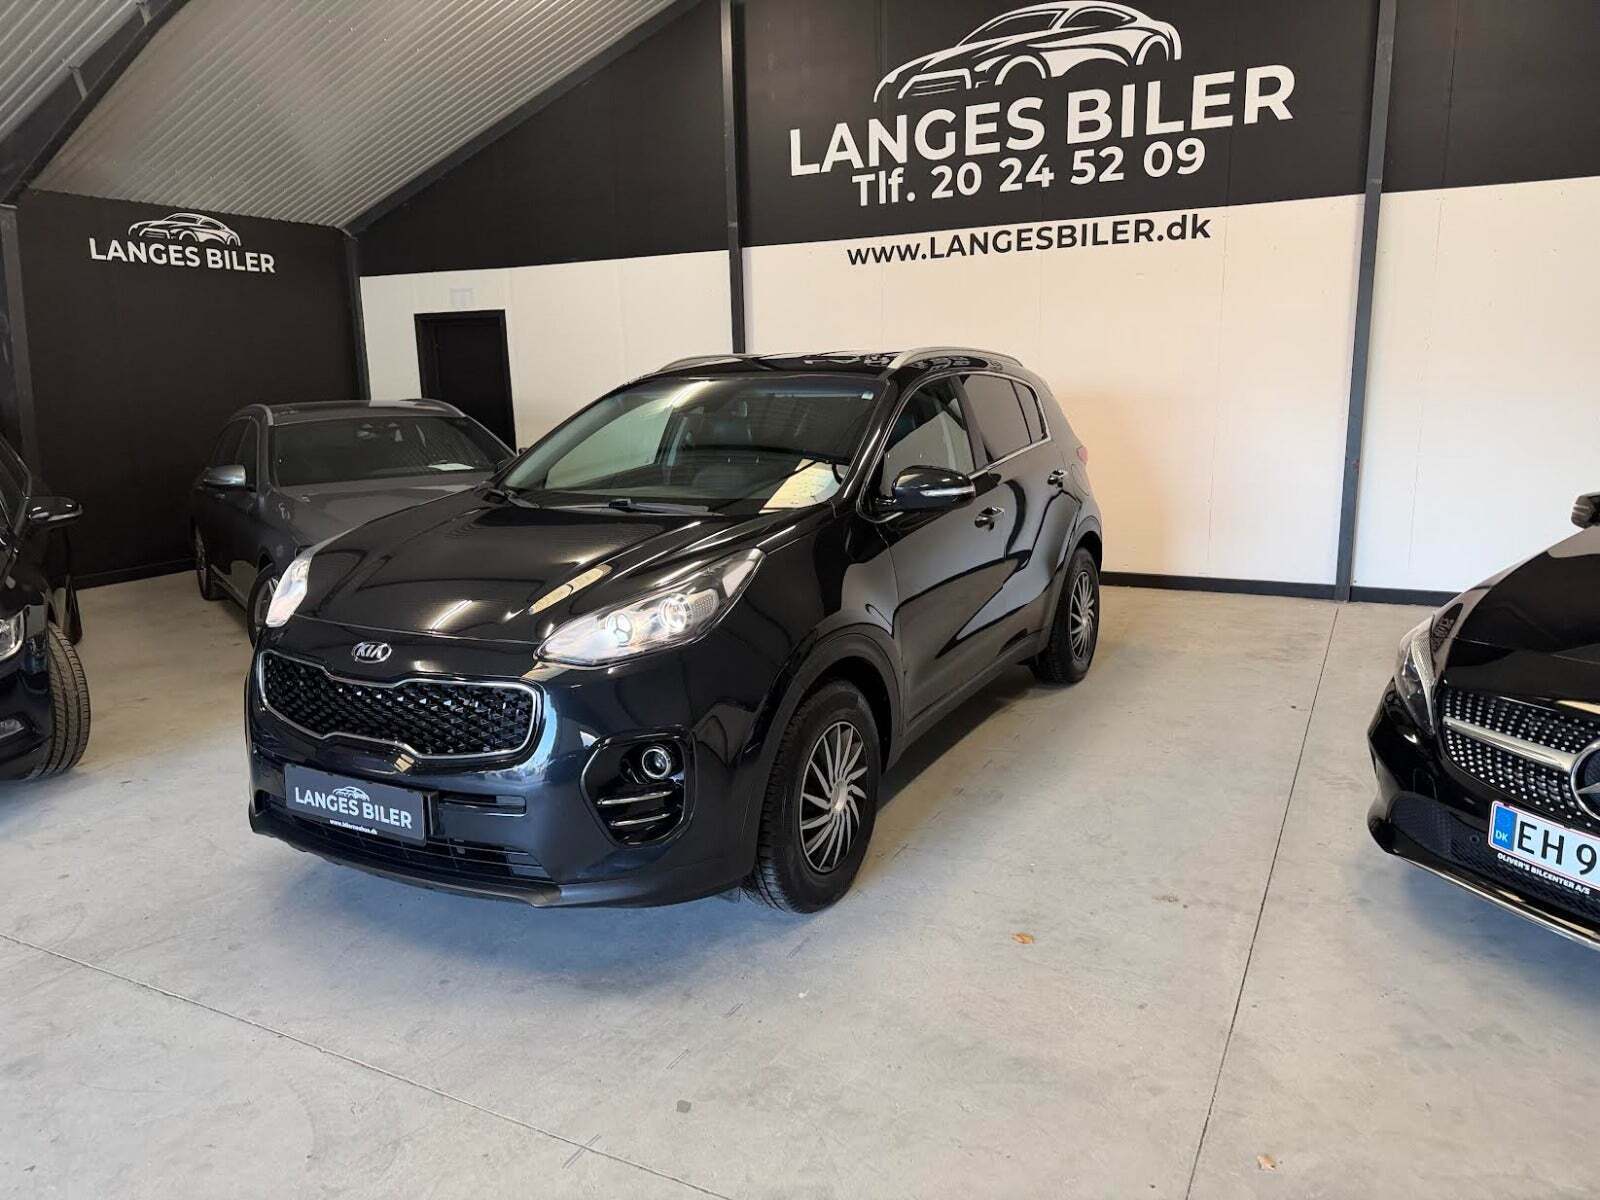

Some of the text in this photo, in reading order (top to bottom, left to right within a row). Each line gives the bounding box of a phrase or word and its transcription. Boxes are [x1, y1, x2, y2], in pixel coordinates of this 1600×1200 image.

[790, 64, 1295, 176] LANGES BILER
[852, 137, 1206, 207] Tlf. 20 24 52 09
[89, 238, 276, 273] LANGES BILER
[846, 213, 1212, 266] www.LANGESBILER.dk
[355, 643, 387, 661] KIA
[295, 787, 412, 829] LANGES BILER
[1495, 830, 1508, 842] DK
[1517, 820, 1598, 876] EH 9
[1497, 852, 1591, 895] OLIVER'S BILCENTER A/S
